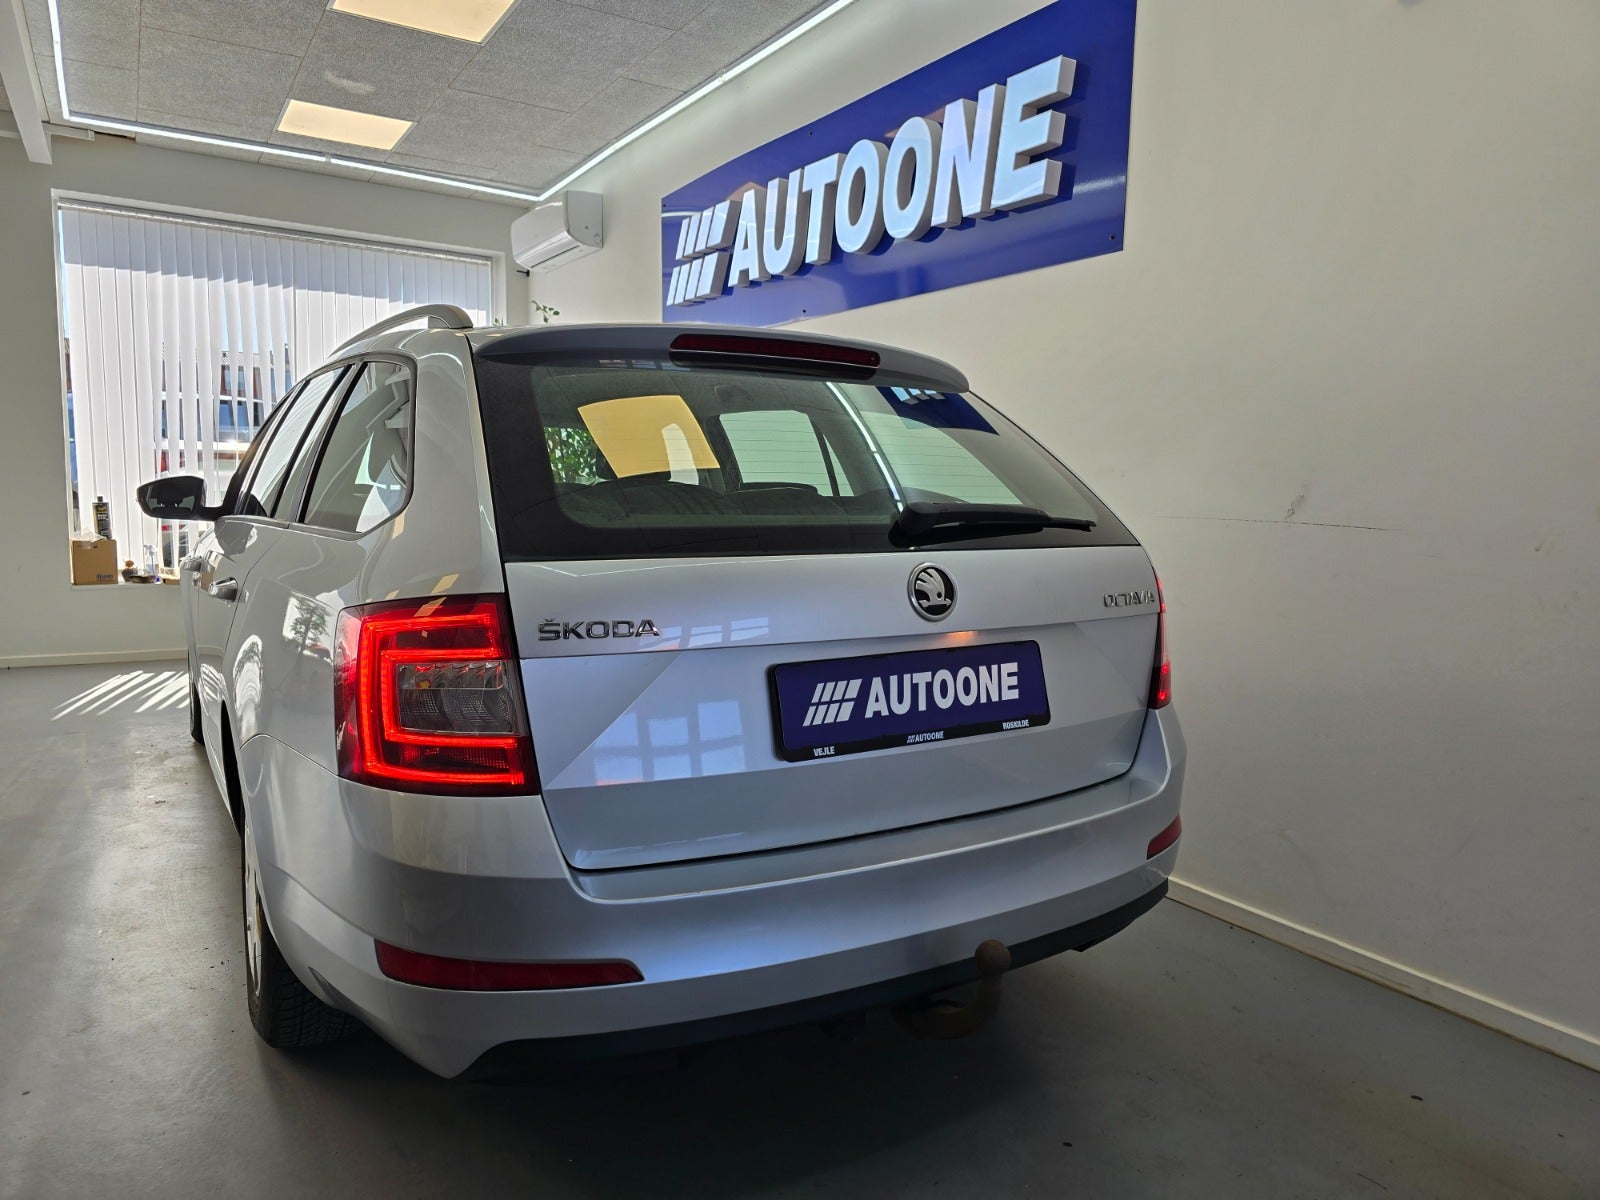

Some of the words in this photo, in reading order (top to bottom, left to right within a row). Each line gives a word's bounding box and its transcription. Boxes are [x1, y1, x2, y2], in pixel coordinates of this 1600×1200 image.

[728, 55, 1076, 287] AUTOONE
[537, 618, 660, 641] ŠKODA
[864, 662, 1019, 718] AUTOONE
[1002, 719, 1030, 729] ROSKILDE
[915, 731, 944, 742] AUTOONE
[813, 746, 835, 757] VEJLE
